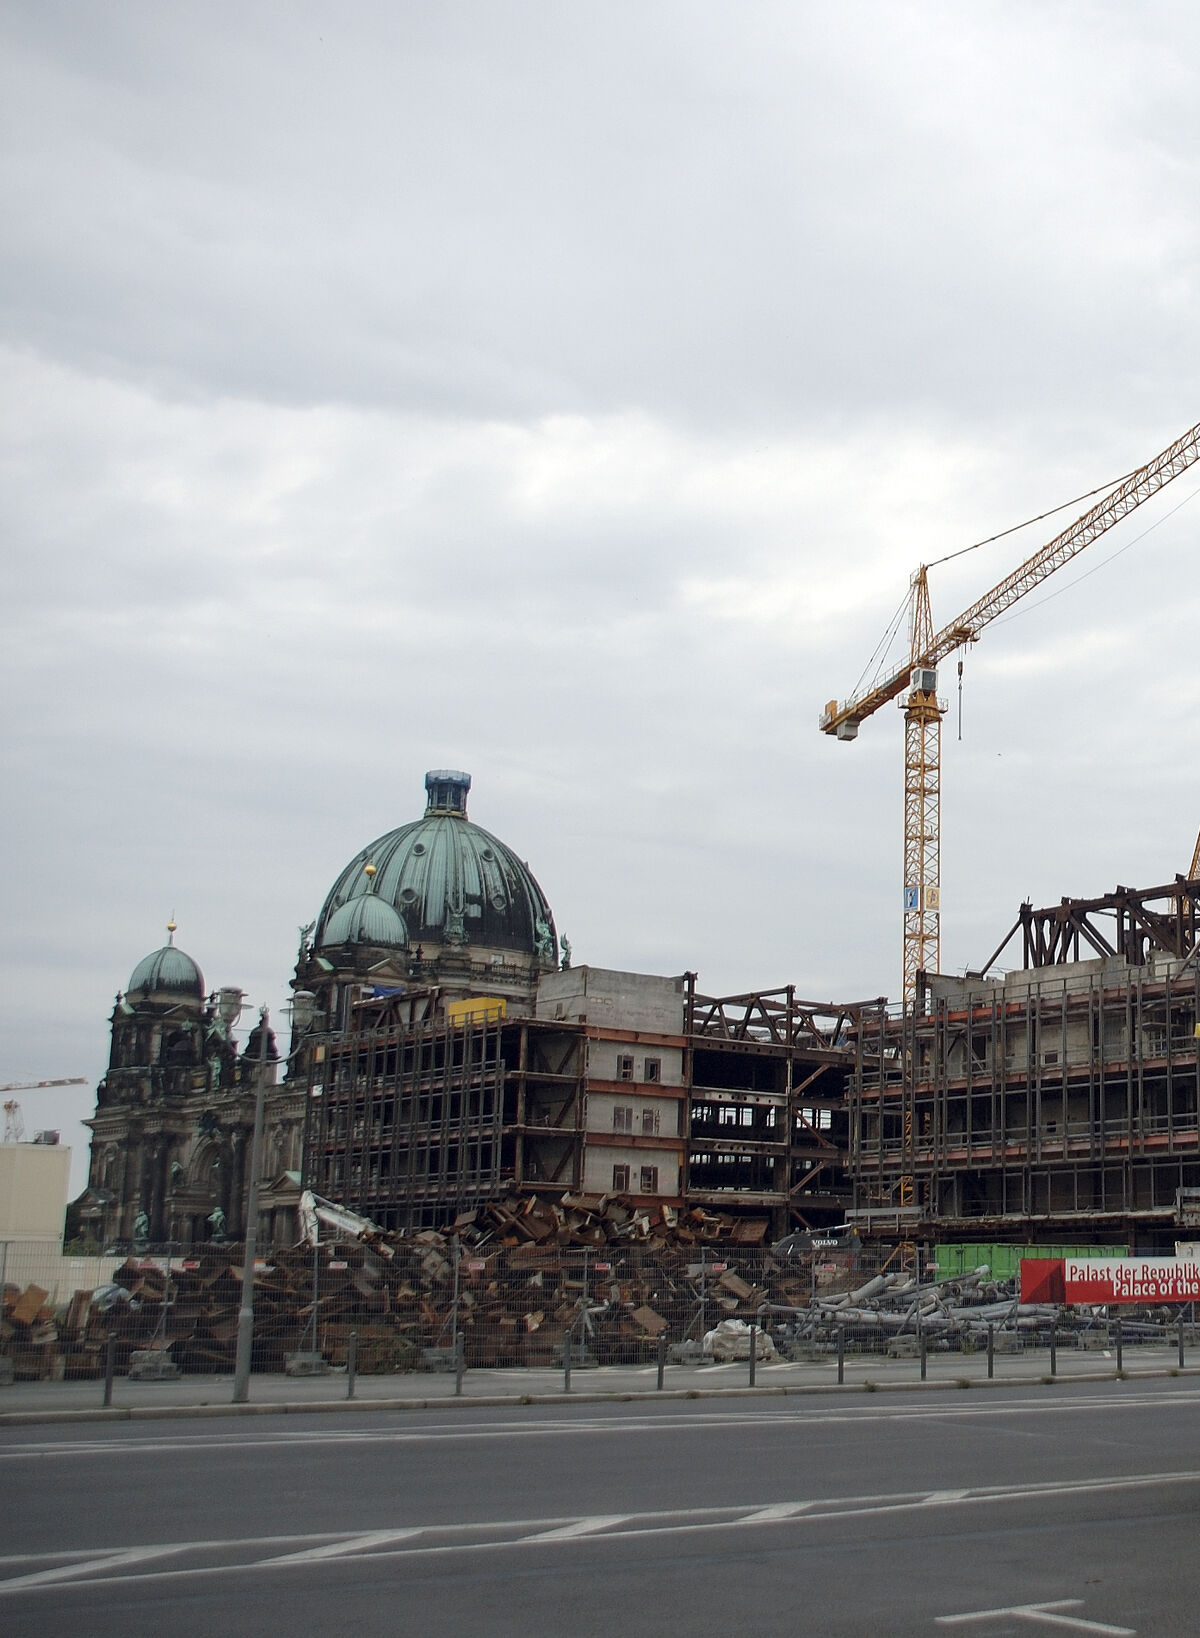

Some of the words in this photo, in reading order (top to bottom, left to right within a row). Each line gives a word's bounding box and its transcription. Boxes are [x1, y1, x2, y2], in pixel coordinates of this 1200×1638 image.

[1070, 1264, 1111, 1282] Palast
[1115, 1264, 1137, 1281] der
[1141, 1262, 1200, 1281] Republik
[1113, 1278, 1156, 1297] Palace
[1159, 1278, 1174, 1295] of
[1176, 1278, 1199, 1295] the
